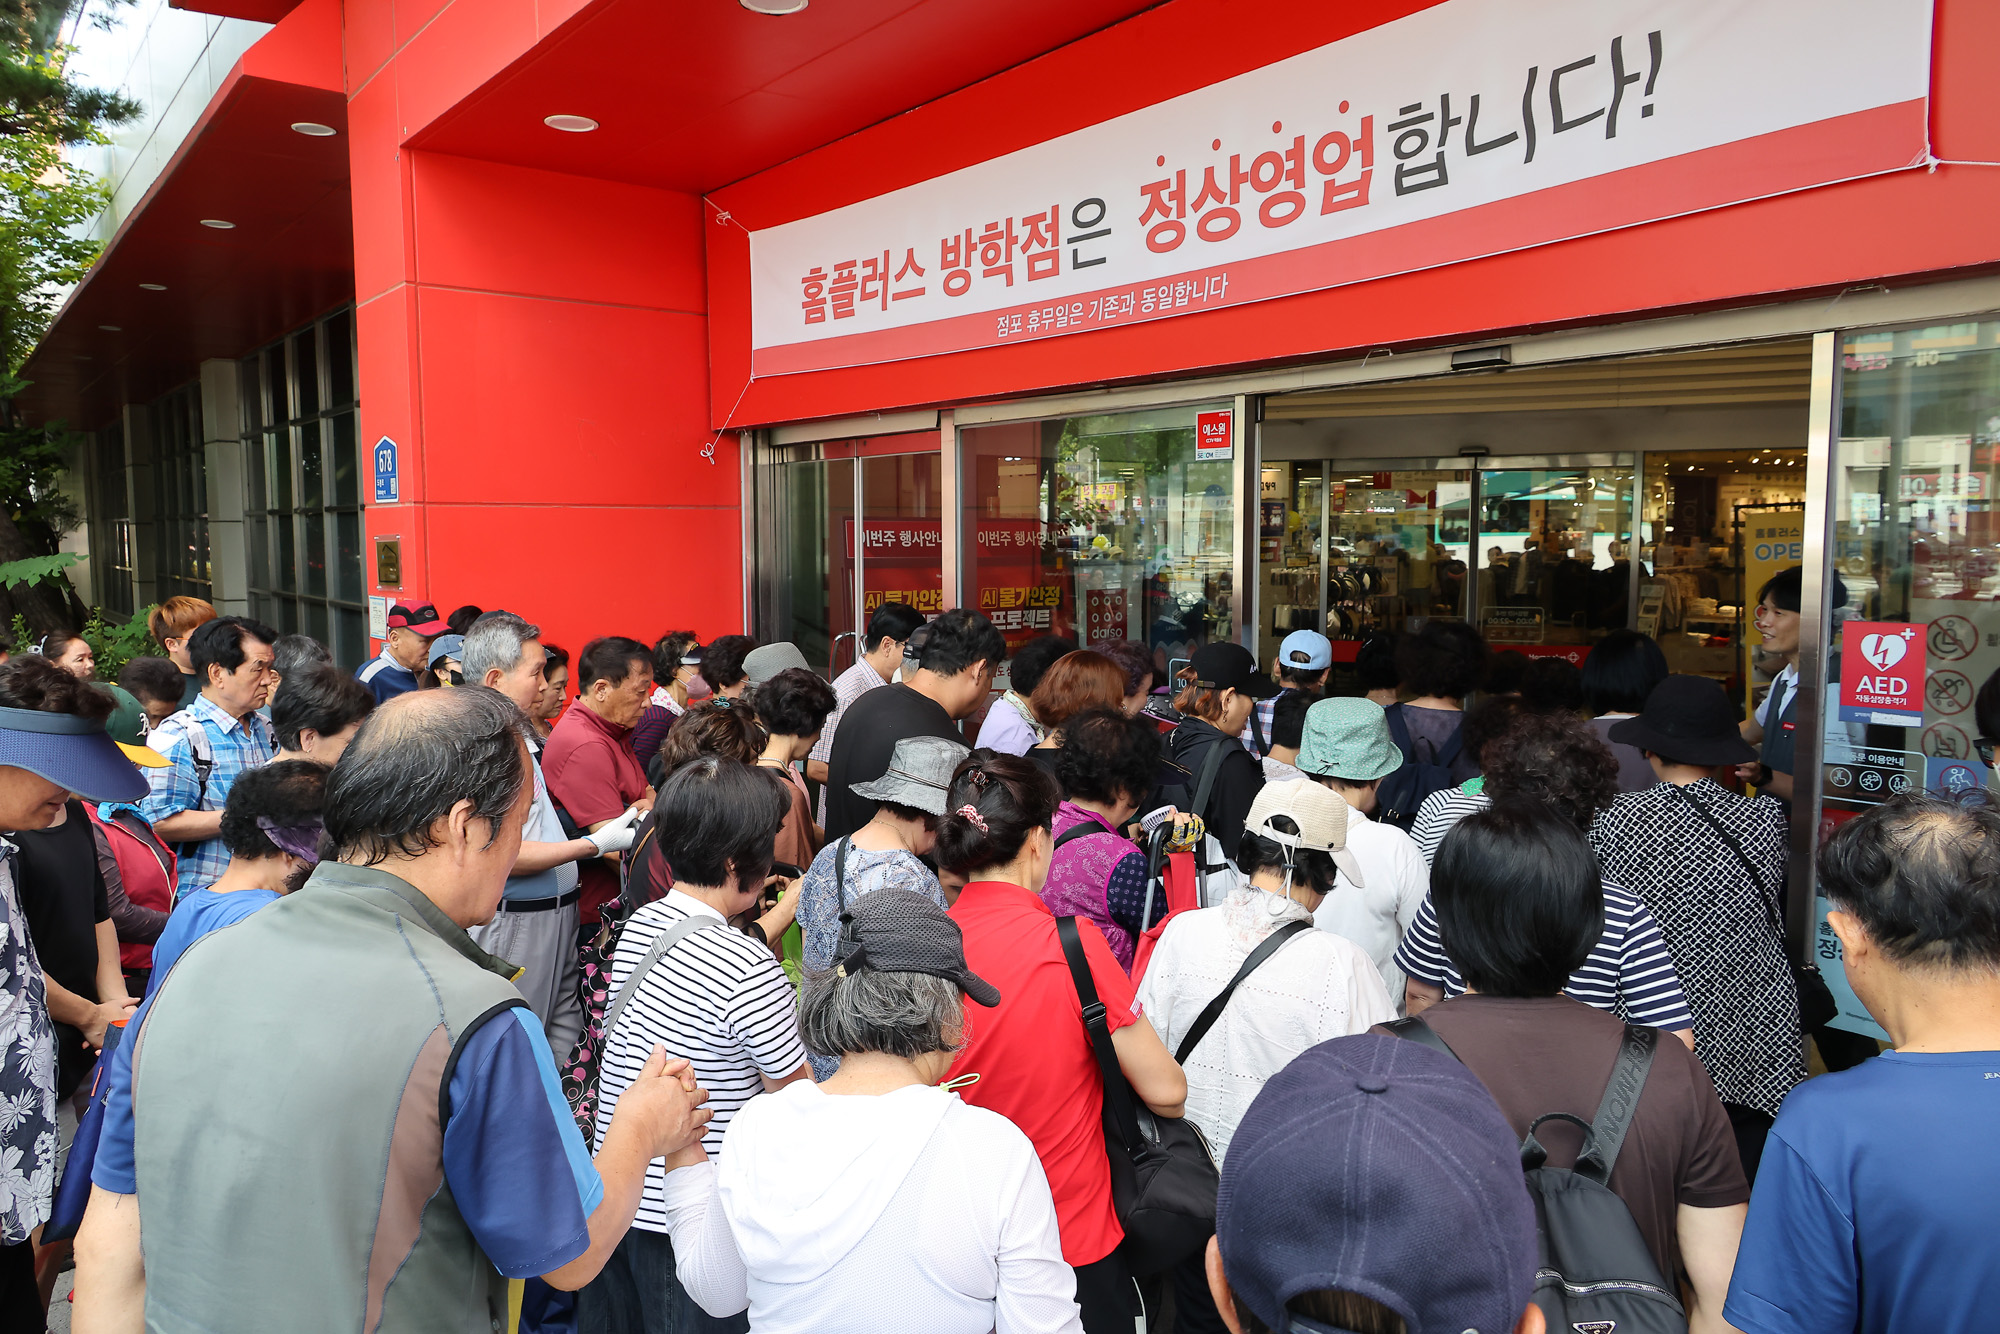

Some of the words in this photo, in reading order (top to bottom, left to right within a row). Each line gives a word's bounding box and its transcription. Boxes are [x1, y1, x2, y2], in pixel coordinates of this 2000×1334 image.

[801, 247, 926, 325] 홈플러스
[940, 196, 1112, 297] 방학점은
[1138, 30, 1662, 254] 정상영업합니다!
[997, 313, 1023, 338] 점포
[1027, 301, 1084, 333] 휴무일은
[1088, 291, 1136, 322] 기존과
[1141, 272, 1229, 314] 동일합니다
[1203, 422, 1225, 436] 에스원
[379, 449, 392, 472] 678
[978, 531, 1011, 547] 이번주
[1014, 531, 1058, 547] 행사안내
[982, 590, 996, 605] AI
[1000, 586, 1061, 608] 물가안정
[991, 609, 1050, 630] 프로젝트
[1091, 625, 1122, 639] daiso
[1855, 675, 1908, 696] AED
[1855, 694, 1907, 706] 자동심장충격기
[1868, 754, 1904, 767] 이용안내
